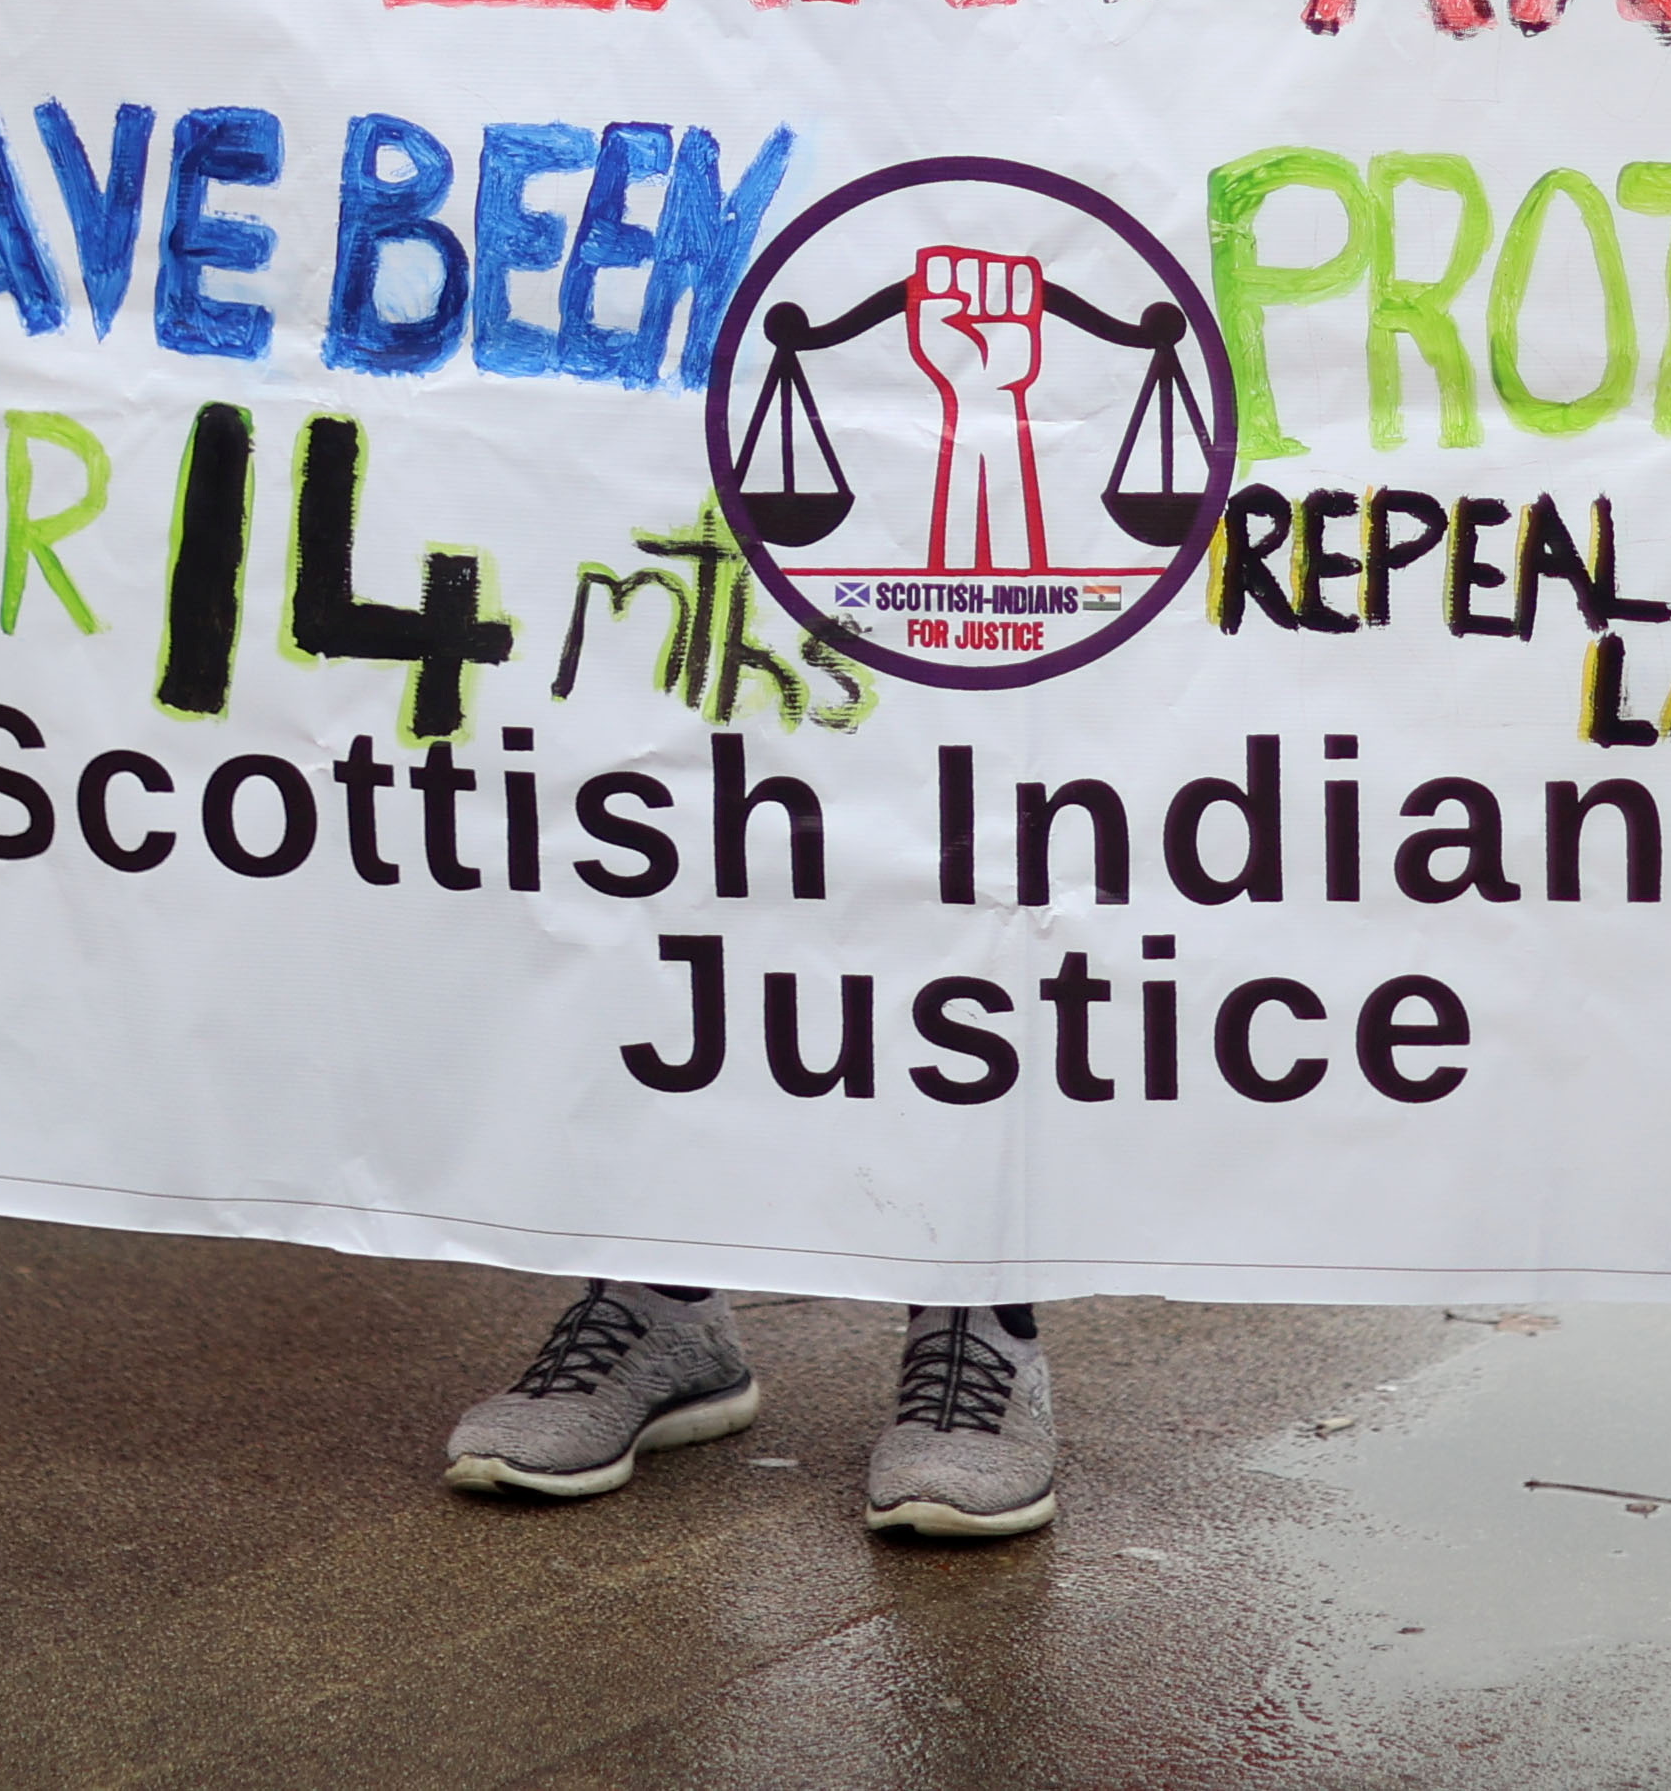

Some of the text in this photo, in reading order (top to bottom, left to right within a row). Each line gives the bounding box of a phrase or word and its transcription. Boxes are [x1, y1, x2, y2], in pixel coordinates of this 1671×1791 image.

[320, 112, 796, 394] BEEN
[155, 400, 514, 750] 14
[875, 581, 1079, 615] SCOTTISH-INDIANS
[906, 618, 1045, 651] FOR JUSTICE
[620, 934, 1475, 1104] Justice
